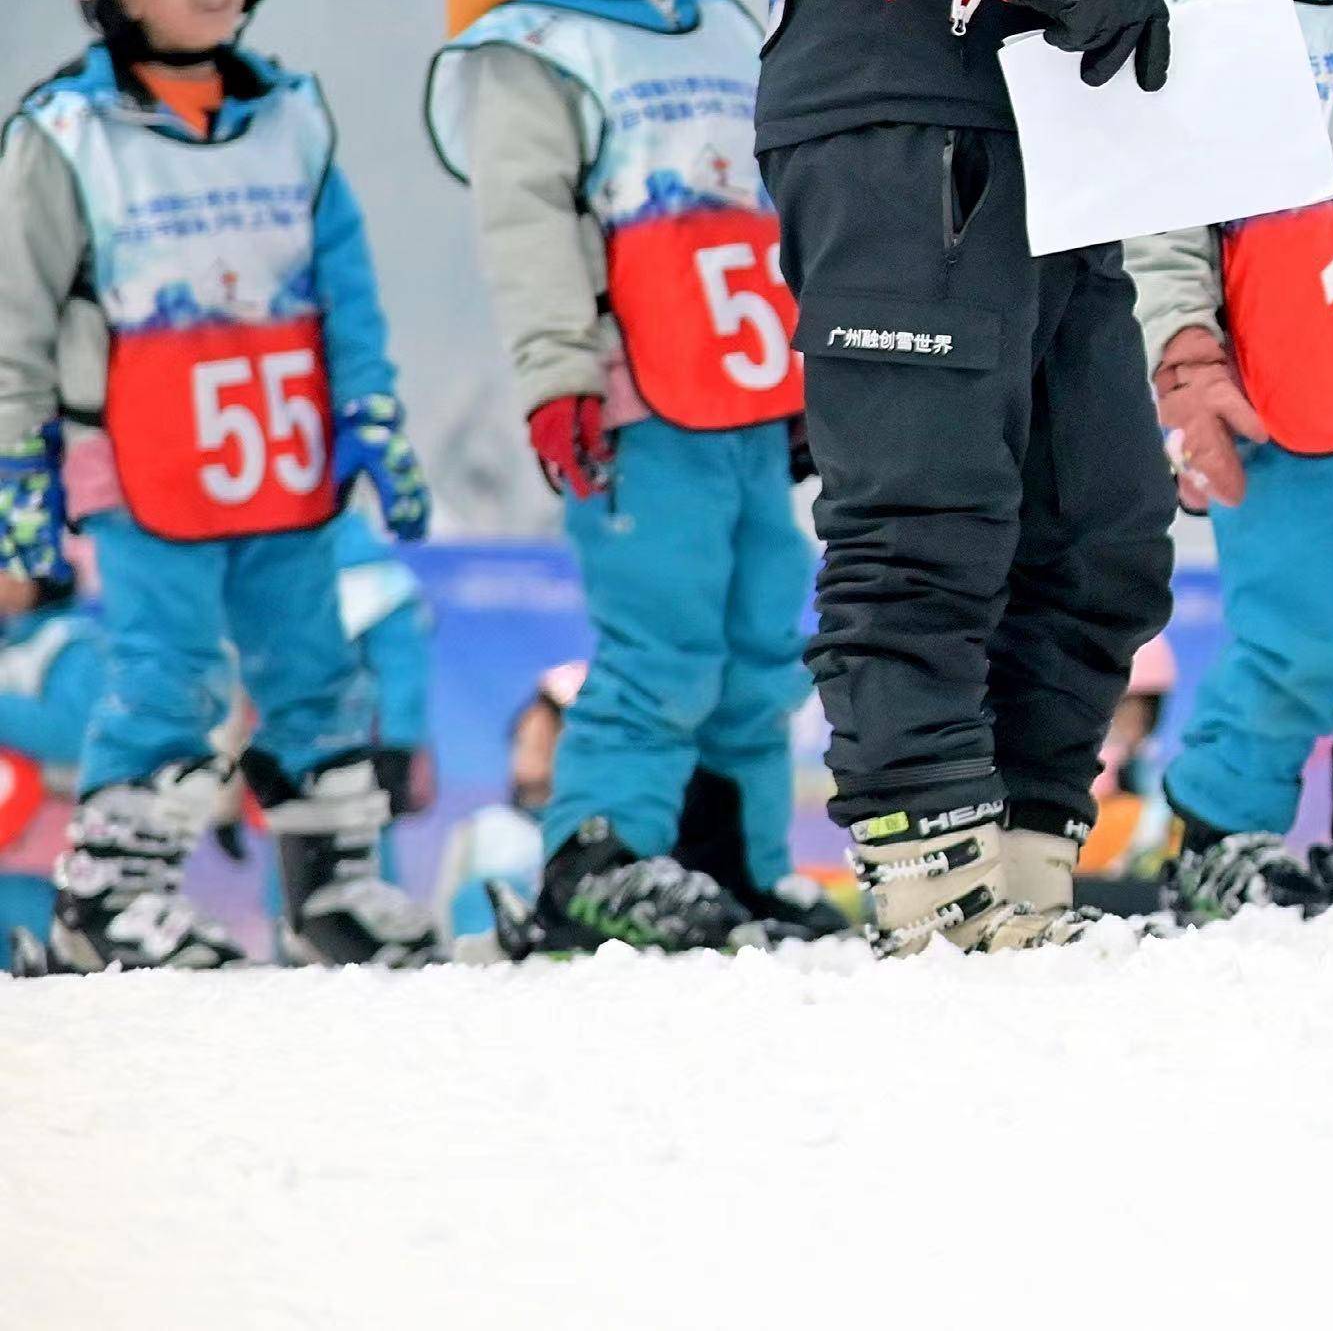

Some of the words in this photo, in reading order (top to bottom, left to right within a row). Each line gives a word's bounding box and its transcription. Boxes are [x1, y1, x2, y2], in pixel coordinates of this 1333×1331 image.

[695, 243, 802, 390] 5
[826, 325, 954, 356] 广州融创雪世界
[192, 348, 327, 503] 55
